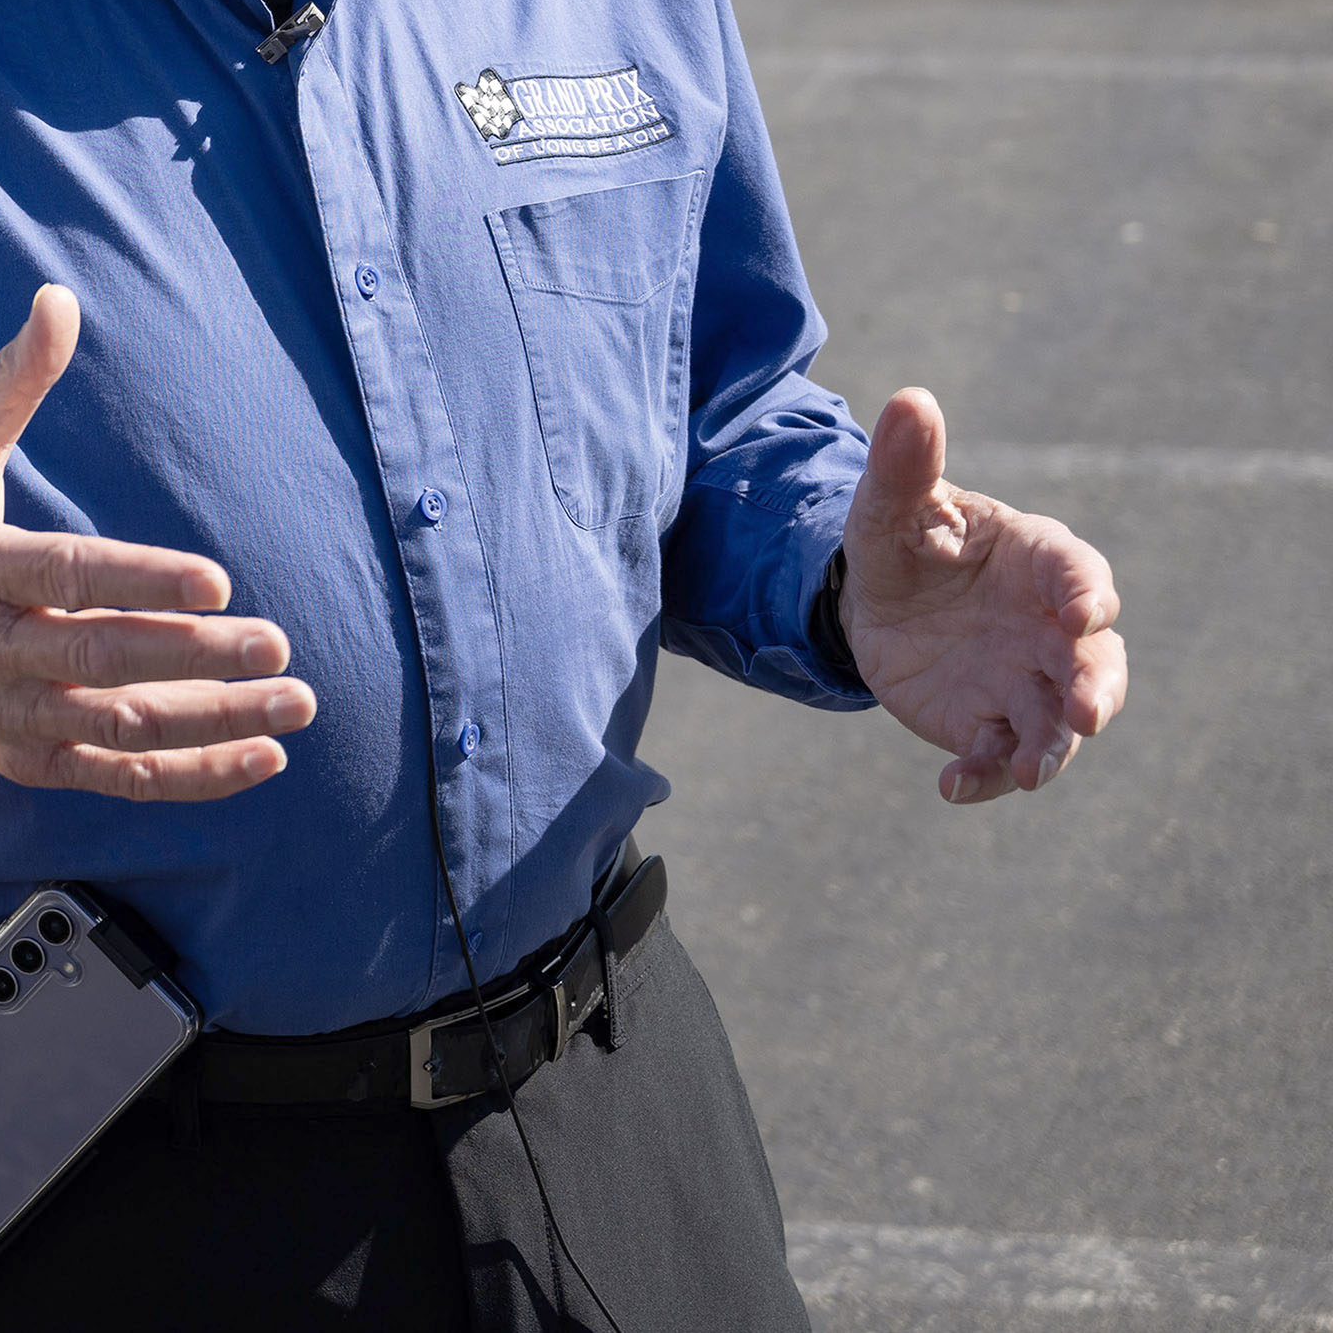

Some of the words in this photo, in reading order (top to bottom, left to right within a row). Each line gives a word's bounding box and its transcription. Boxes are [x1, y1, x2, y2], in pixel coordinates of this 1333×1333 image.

[513, 78, 587, 119] GRAND
[586, 70, 654, 114] PRIX
[517, 105, 659, 139] ASSOCIATION
[495, 145, 524, 162] OF
[533, 138, 585, 154] LONG
[587, 123, 669, 153] BEACH
